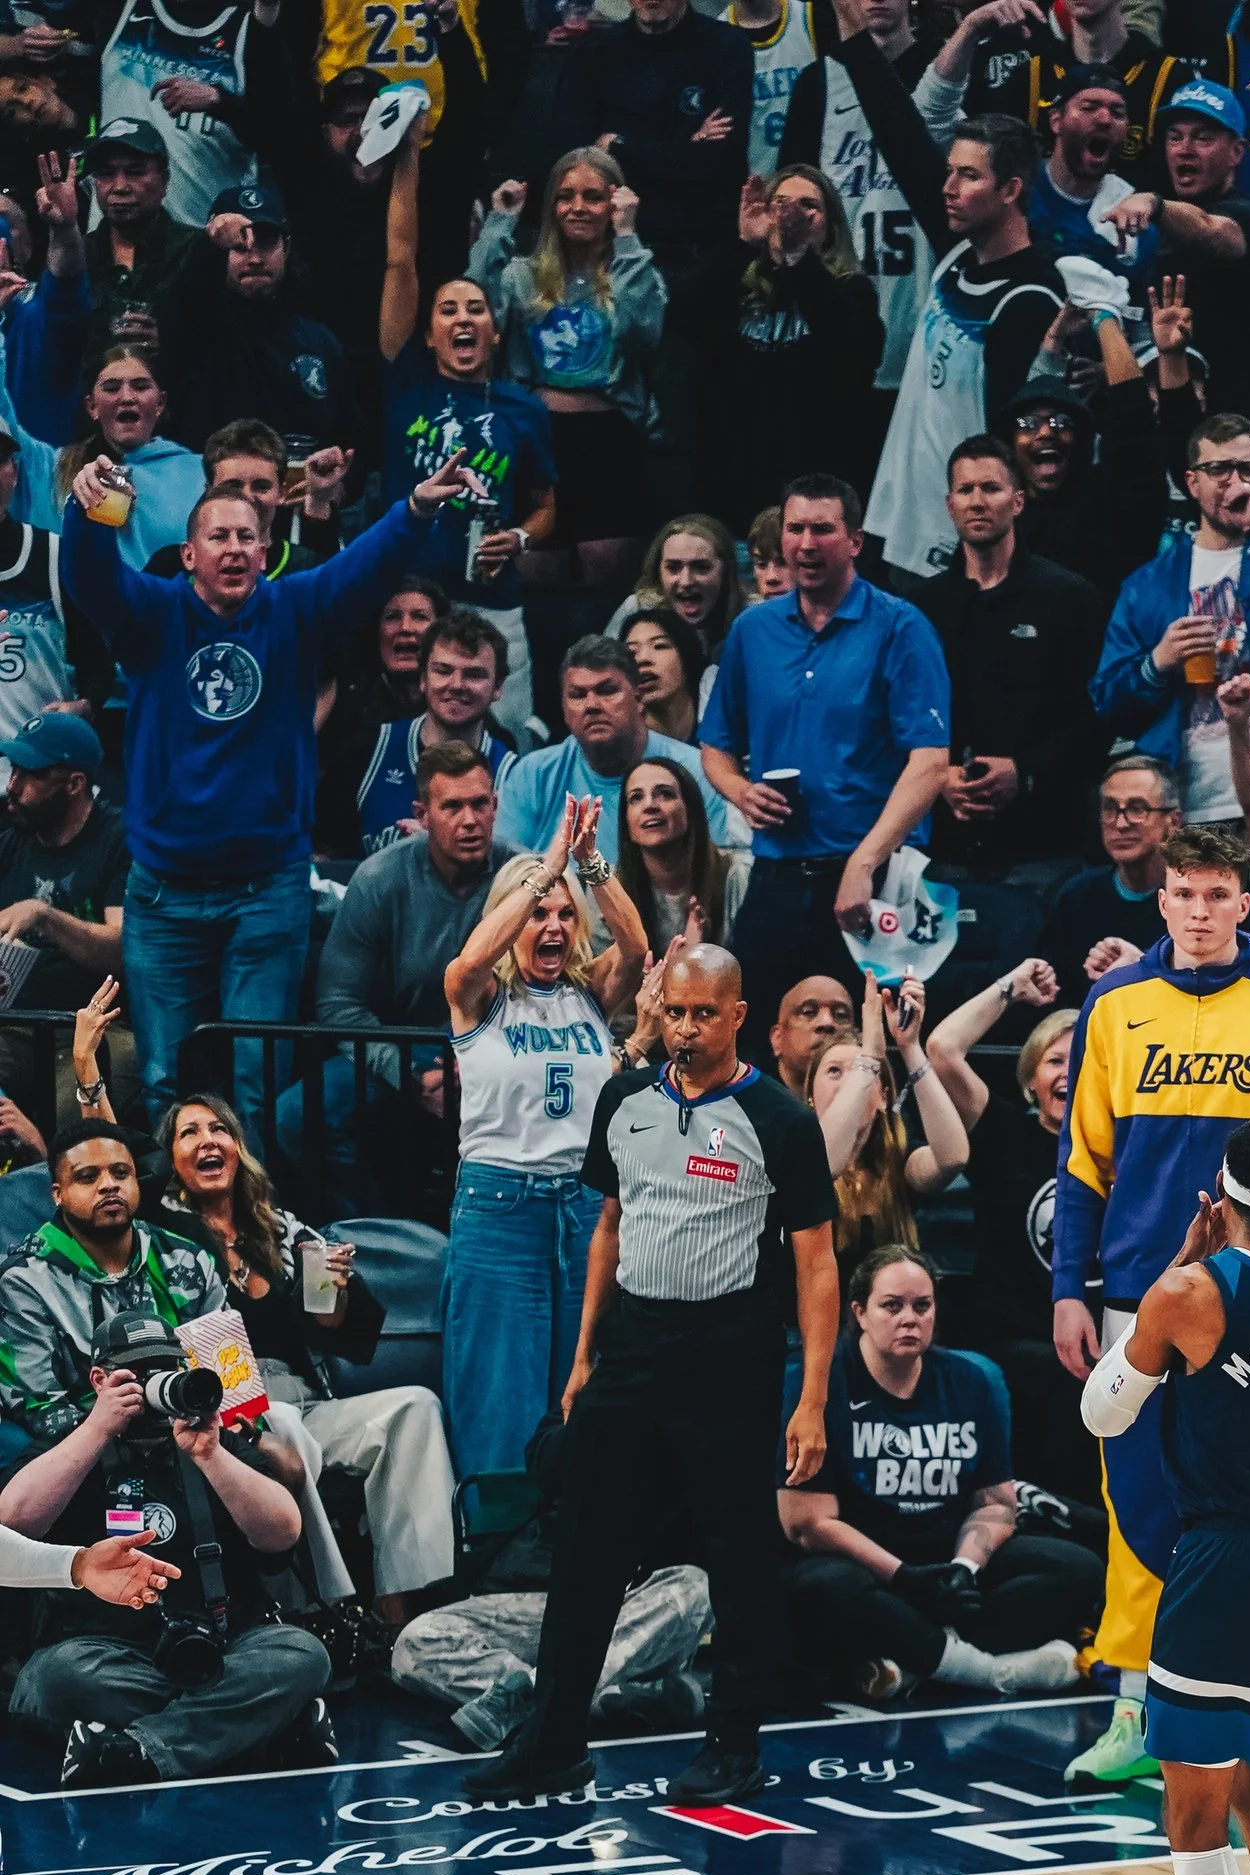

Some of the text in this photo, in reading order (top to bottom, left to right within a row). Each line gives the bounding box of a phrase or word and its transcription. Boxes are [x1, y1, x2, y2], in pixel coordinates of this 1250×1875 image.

[364, 4, 437, 67] 23
[861, 210, 916, 276] 15
[502, 1021, 603, 1057] WOLVES
[545, 1063, 573, 1119] 5
[688, 1159, 736, 1178] Emirates
[852, 1420, 978, 1459] WOLVES
[875, 1459, 962, 1496] BACK
[808, 1757, 914, 1783] by
